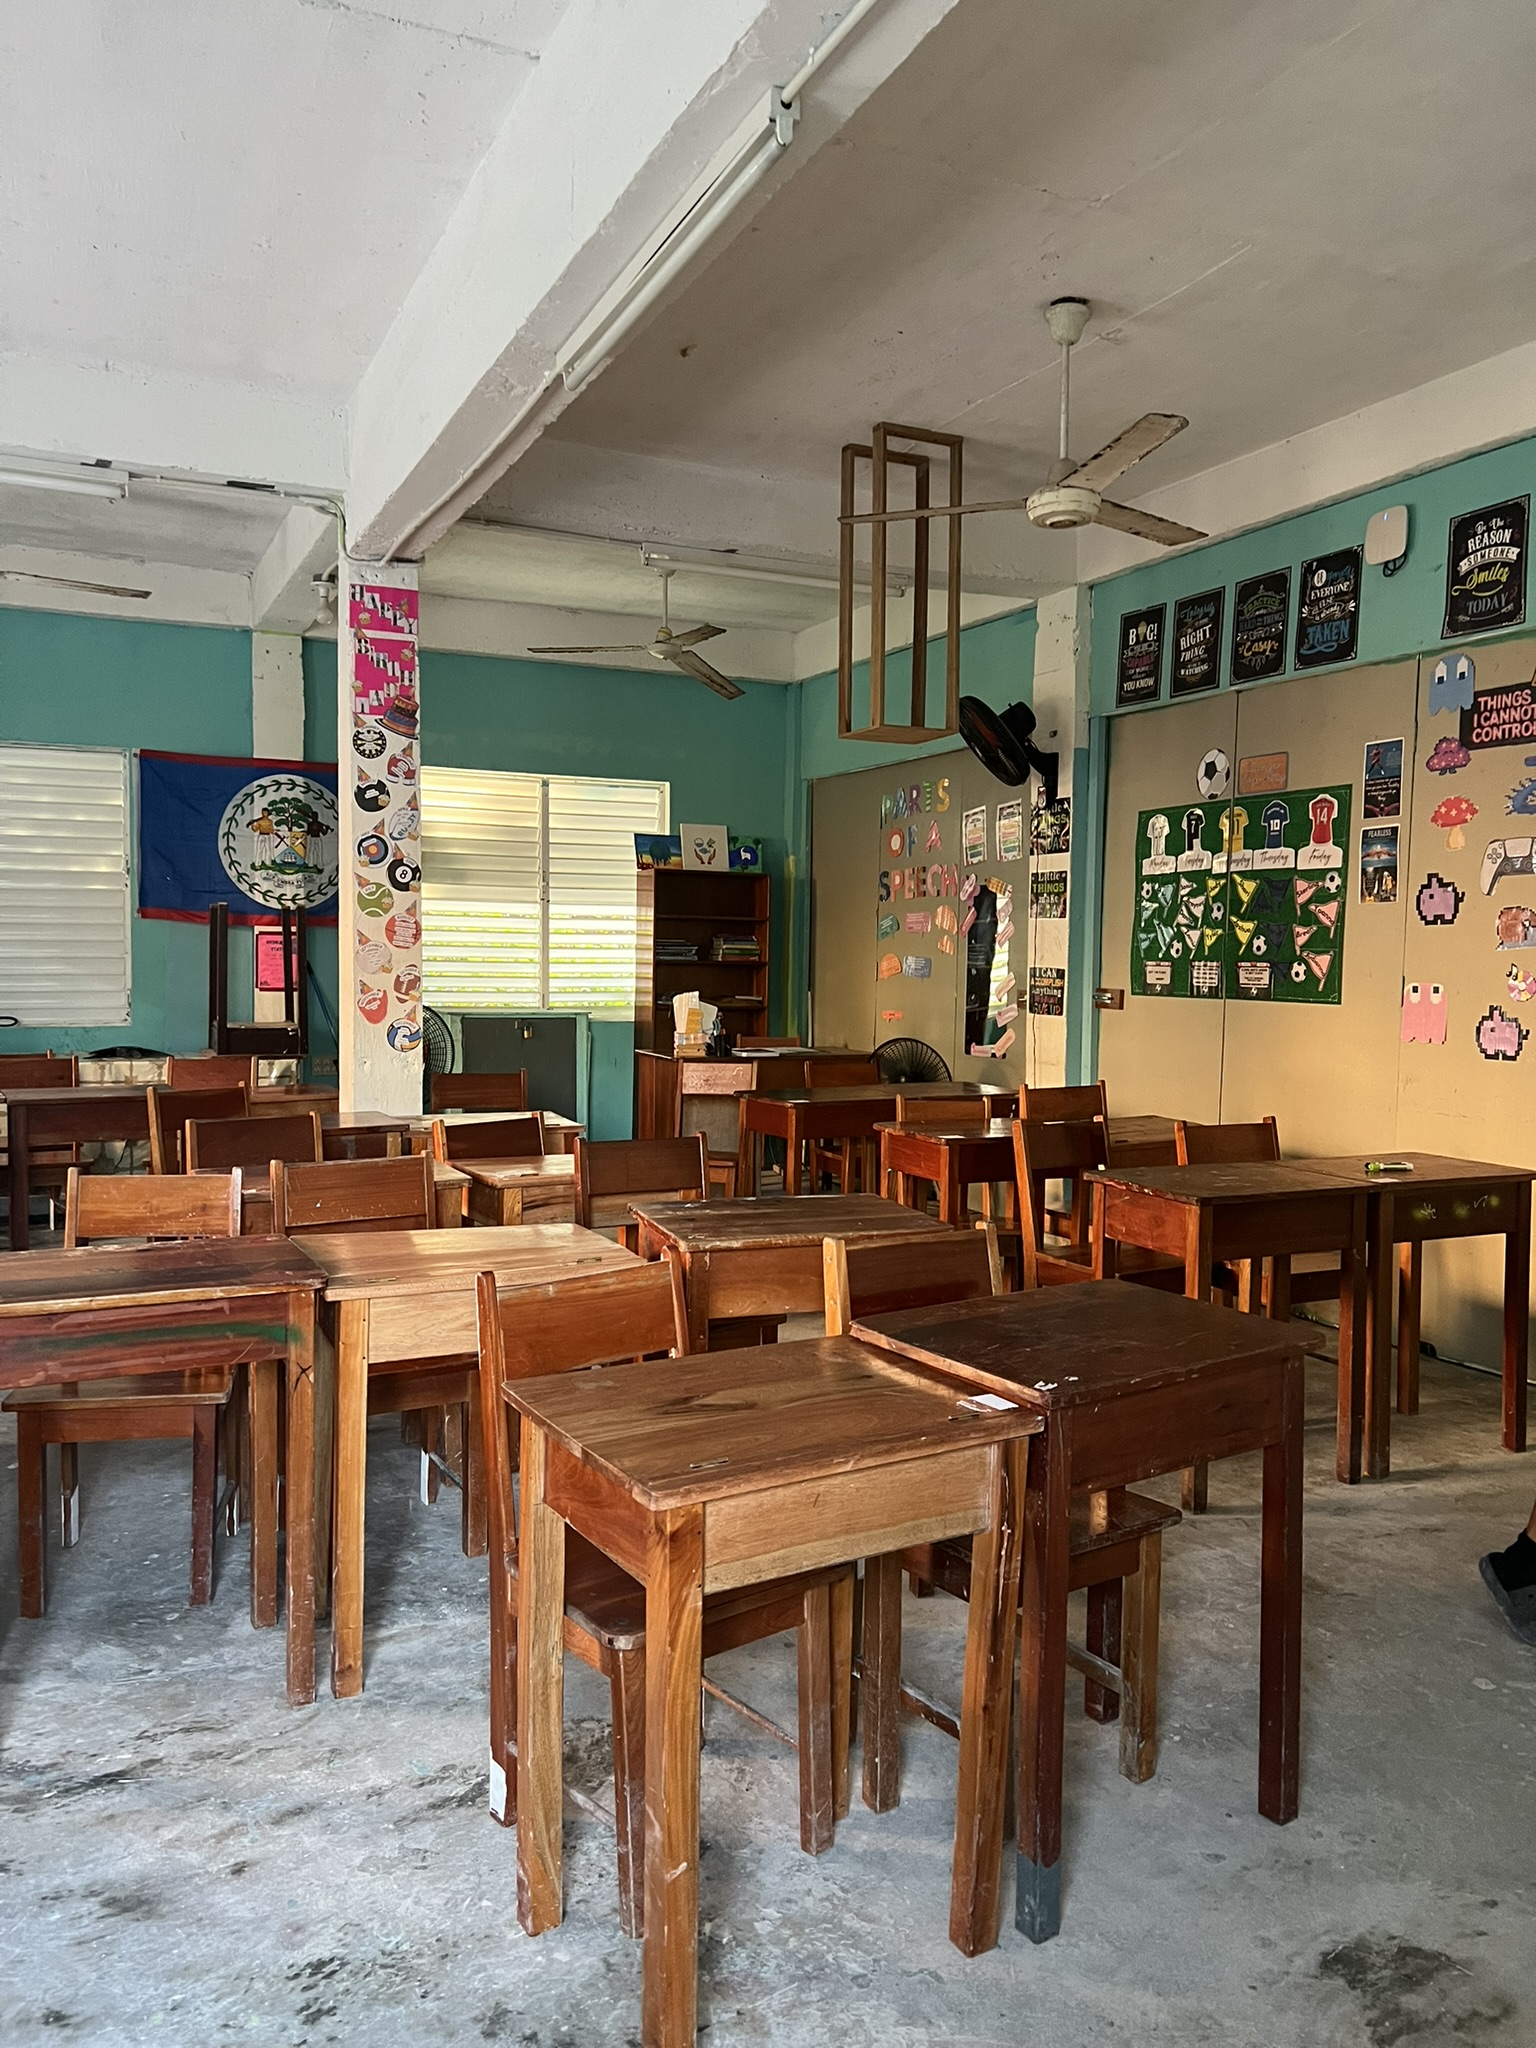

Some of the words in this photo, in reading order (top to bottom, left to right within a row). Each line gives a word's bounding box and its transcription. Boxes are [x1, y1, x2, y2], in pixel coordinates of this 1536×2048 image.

[1467, 528, 1513, 553] REASON
[1467, 547, 1511, 566] SOMEONE
[1461, 562, 1510, 591] Smiles
[1311, 581, 1350, 600] EVERYONE
[350, 585, 417, 634] HAPPY
[1467, 592, 1509, 615] TODAY
[1180, 624, 1213, 650] RIGHT
[1306, 619, 1351, 644] TAKEN
[1180, 645, 1206, 662] THING
[1243, 640, 1274, 657] Easy
[1180, 662, 1209, 676] WATCHING
[1123, 680, 1135, 691] YOU
[1136, 676, 1155, 689] KNOW
[1477, 689, 1532, 712] THINGS
[1473, 713, 1478, 728] I
[881, 777, 950, 825] PARTS
[1270, 819, 1280, 831] 10
[1316, 807, 1328, 825] 14
[1191, 821, 1196, 834] 7
[1367, 829, 1392, 838] FEARLESS
[887, 824, 918, 858] OF
[924, 819, 942, 854] A
[1260, 850, 1289, 865] Thursday
[1308, 848, 1333, 866] Friday
[399, 869, 408, 880] 8
[879, 863, 958, 902] SPEECH
[1038, 871, 1060, 881] Little
[1032, 882, 1064, 893] THINGS
[1041, 967, 1057, 978] CAN
